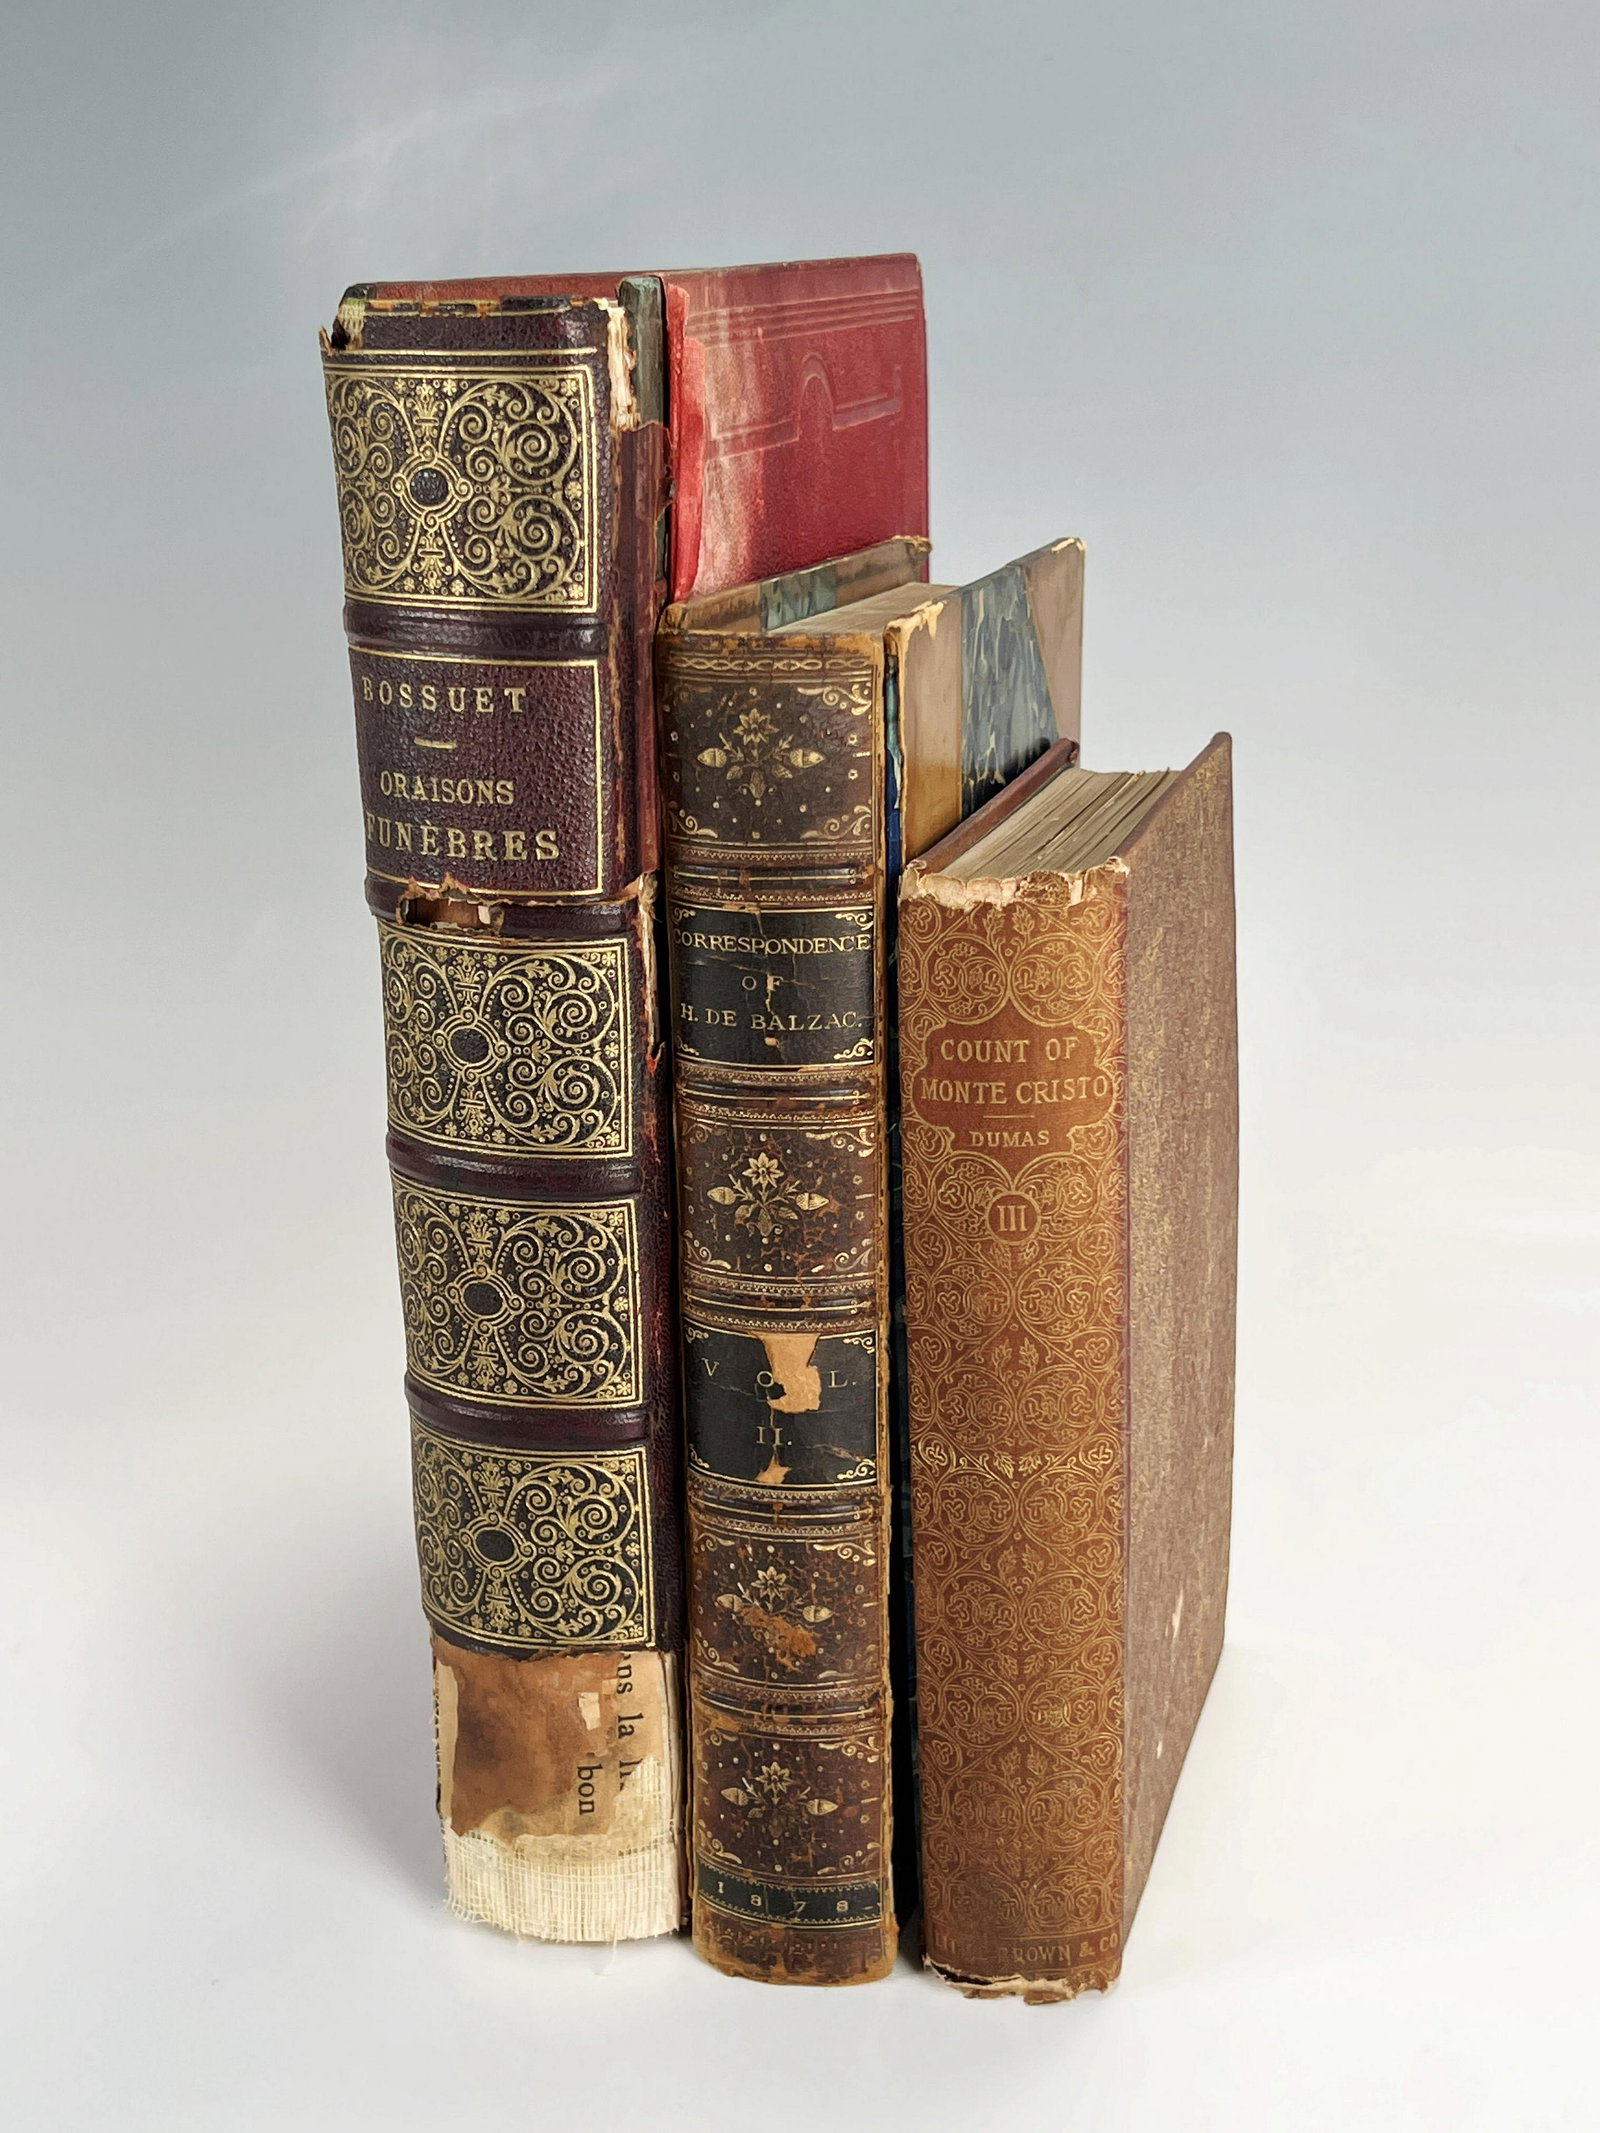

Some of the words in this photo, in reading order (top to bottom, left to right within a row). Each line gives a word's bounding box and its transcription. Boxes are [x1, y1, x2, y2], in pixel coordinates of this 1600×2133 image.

[361, 676, 527, 713] BOSSUET
[379, 770, 515, 806] ORAISONS
[366, 811, 560, 862] FUNÈBRES
[673, 928, 872, 955] CORRESPONDENCE
[741, 975, 784, 992] OF
[680, 1002, 699, 1022] H.
[705, 1008, 737, 1027] DE
[750, 1011, 863, 1031] BALZAC.
[940, 1038, 1030, 1063] COUNT
[1045, 1036, 1080, 1060] OF
[920, 1077, 1007, 1104] MONTE
[1015, 1075, 1108, 1104] CRISTO
[969, 1130, 1050, 1148] DUMAS
[997, 1205, 1028, 1232] III
[756, 1426, 793, 1446] II.
[618, 1712, 644, 1739] la
[577, 1763, 603, 1815] bon
[1080, 1941, 1095, 1958] &
